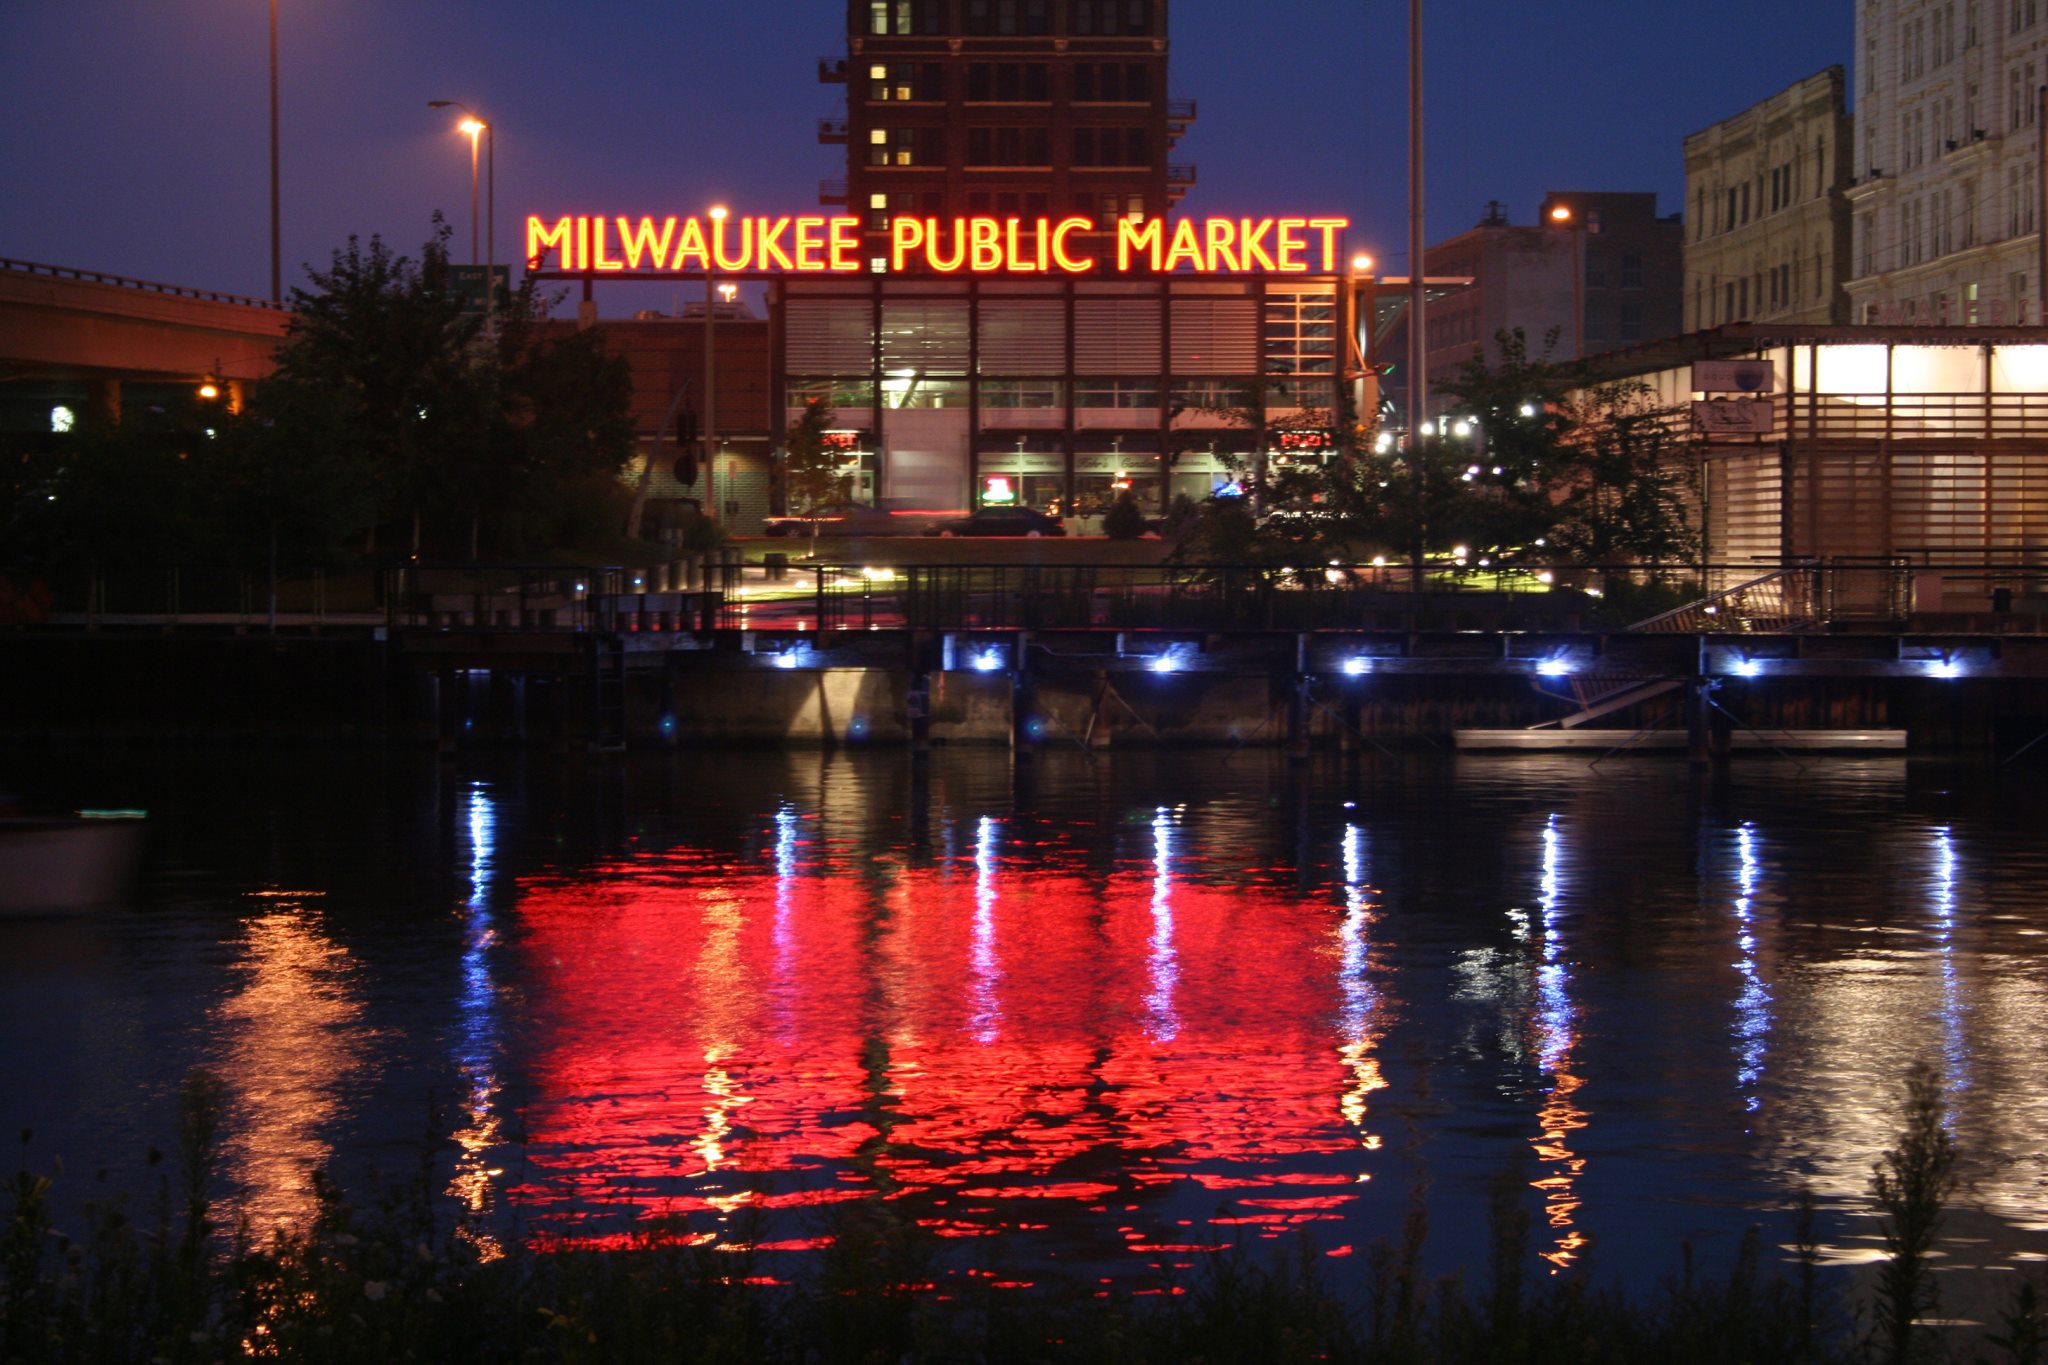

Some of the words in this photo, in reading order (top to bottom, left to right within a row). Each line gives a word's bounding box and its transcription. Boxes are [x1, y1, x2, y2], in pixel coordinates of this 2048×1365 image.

[527, 216, 860, 271] MILWAUKEE
[892, 217, 1093, 272] PUBLIC
[1117, 218, 1349, 272] MARKET
[1752, 336, 1816, 349] SCHLITZ
[1912, 337, 1969, 350] NATURE
